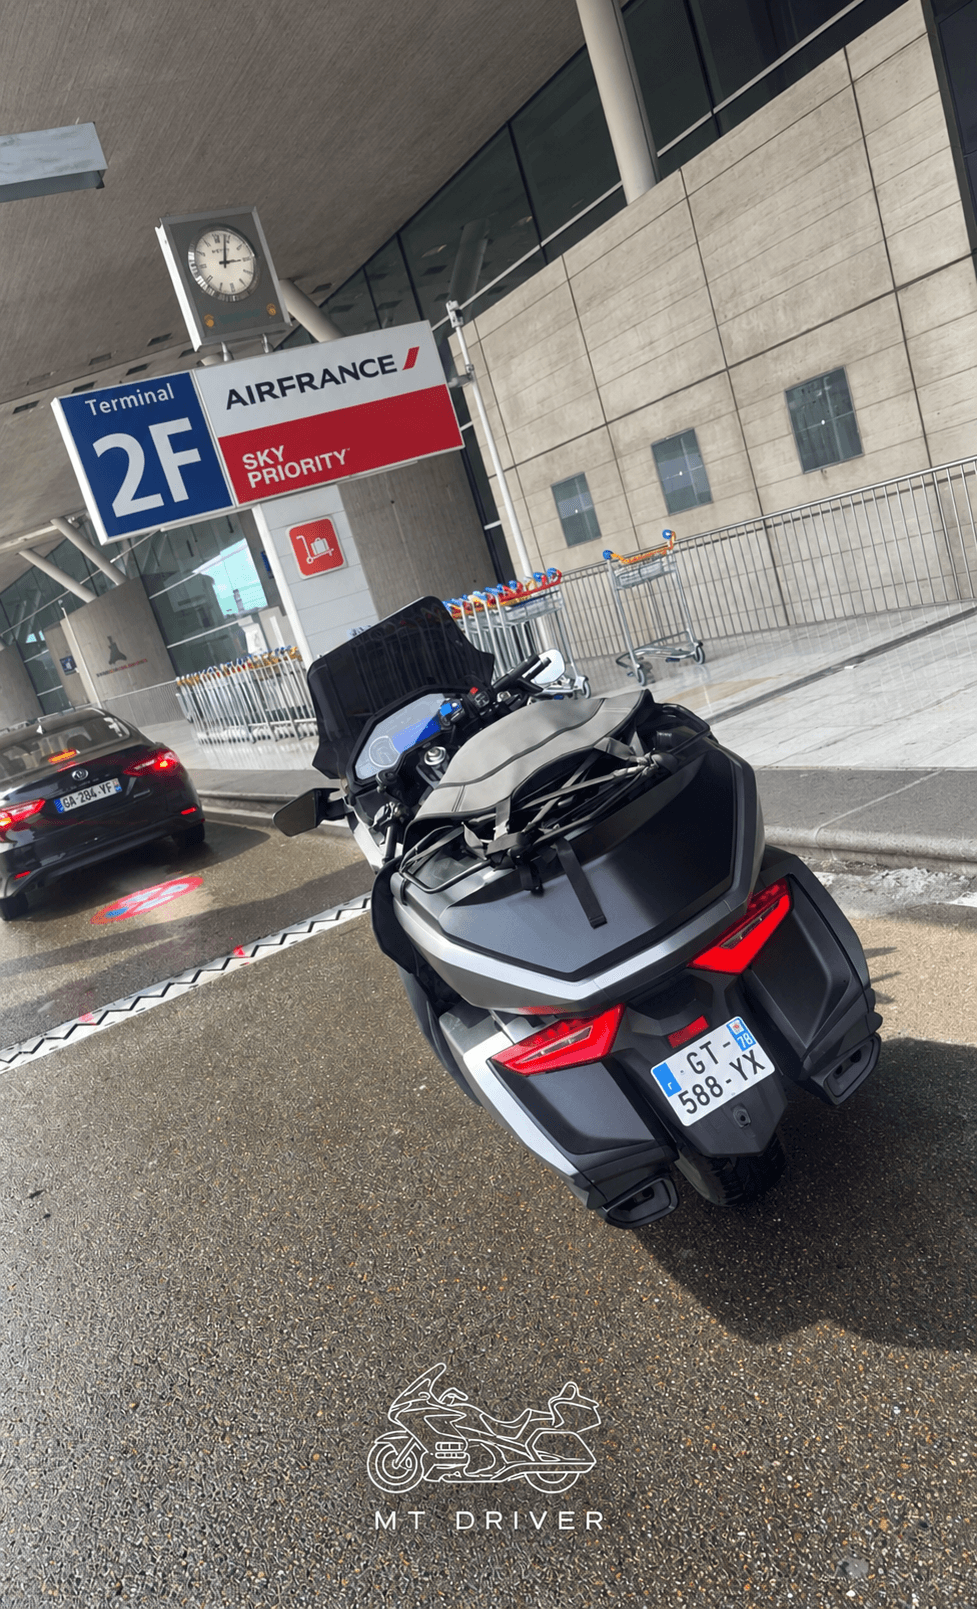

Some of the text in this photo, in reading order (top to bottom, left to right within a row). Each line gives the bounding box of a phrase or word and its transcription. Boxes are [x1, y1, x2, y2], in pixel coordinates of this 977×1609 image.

[85, 382, 175, 416] Terminal
[226, 354, 397, 411] AIRFRANCE
[92, 416, 202, 518] 2F
[242, 445, 285, 470] SKY
[247, 448, 347, 489] PRIORITY
[736, 1032, 754, 1049] 78
[678, 1049, 766, 1115] 588-YX
